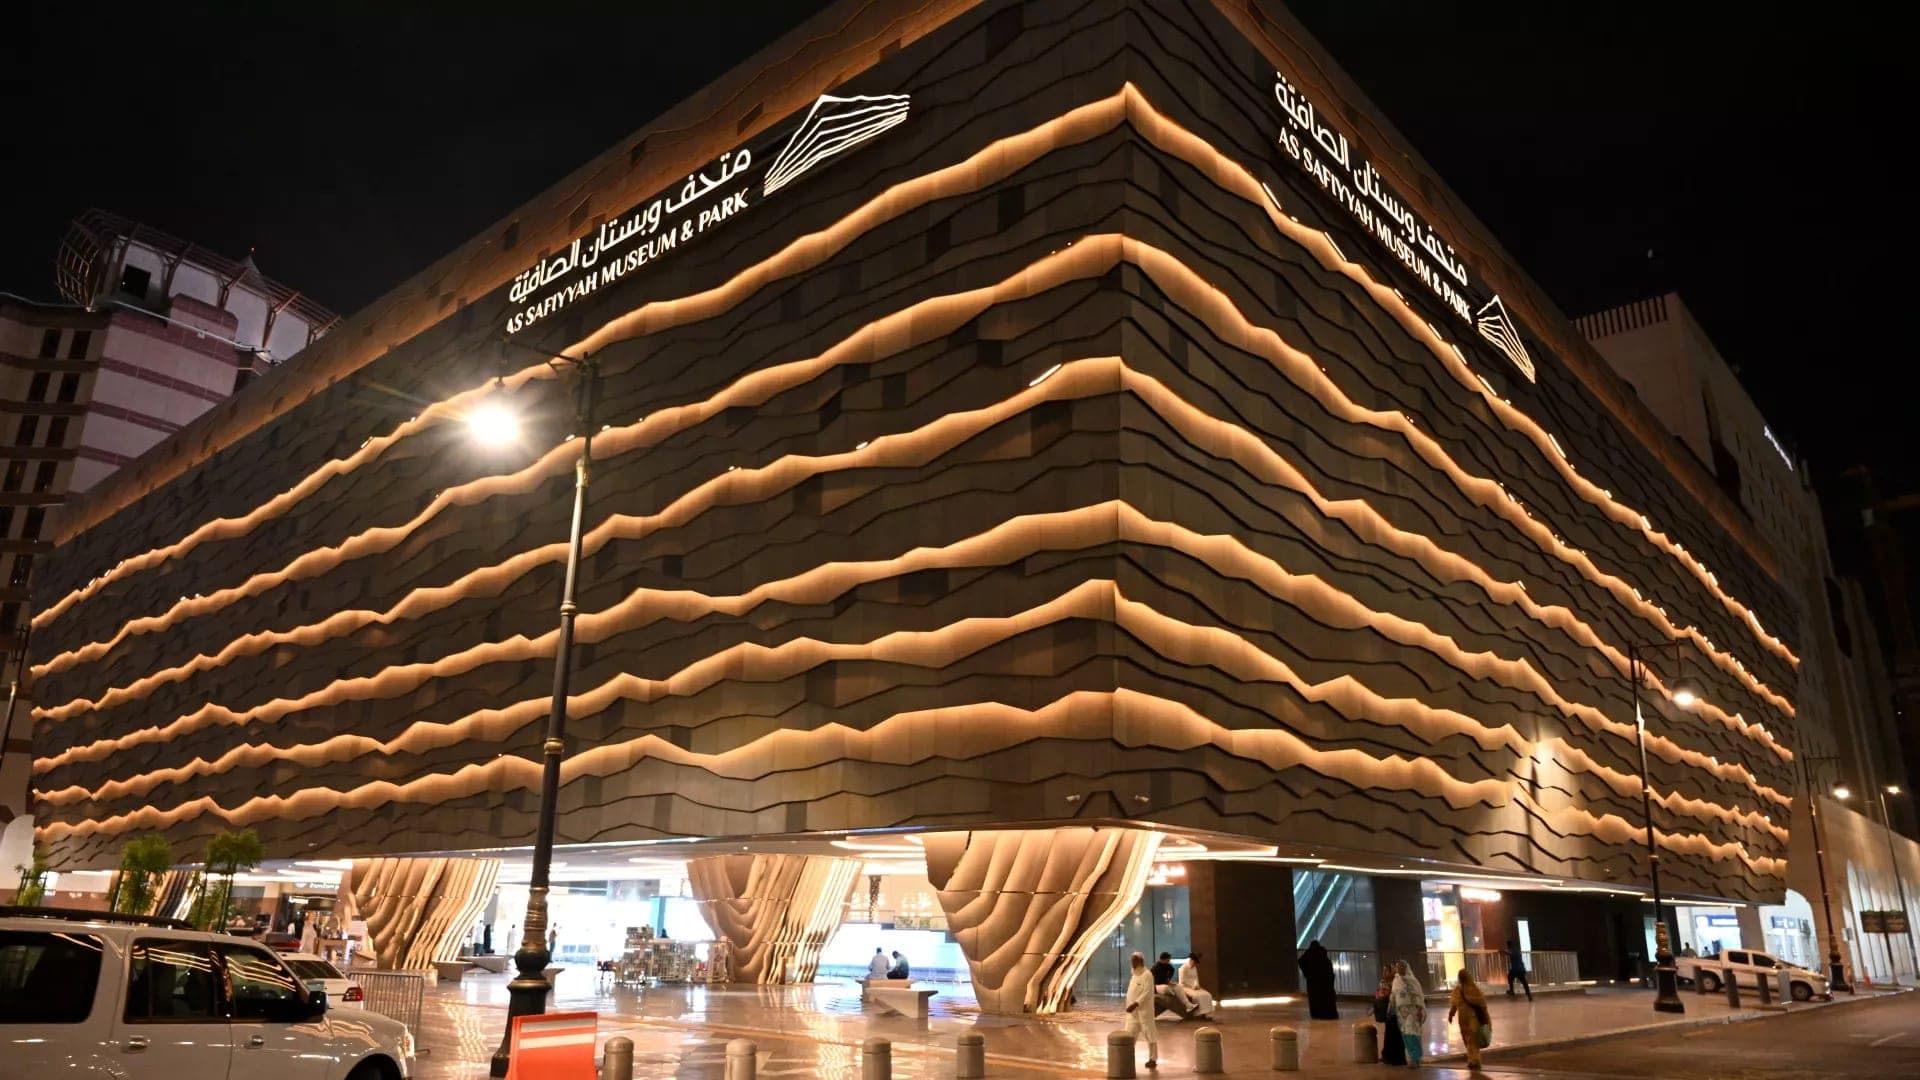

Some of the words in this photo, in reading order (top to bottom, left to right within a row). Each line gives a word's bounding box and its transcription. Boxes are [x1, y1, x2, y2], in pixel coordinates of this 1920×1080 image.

[665, 149, 752, 214] متحف
[1353, 160, 1416, 244] وبستان
[506, 312, 524, 334] AS
[525, 271, 598, 326] SAFIYYAH
[601, 227, 677, 285] MUSEUM
[680, 219, 694, 242] &
[698, 187, 749, 233] PARK
[581, 200, 663, 268] وبستان
[1278, 126, 1301, 160] AS
[1302, 146, 1374, 232] SAFIYYAH
[1375, 216, 1432, 287] MUSEUM
[1432, 272, 1442, 296] &
[1442, 280, 1473, 325] PARK
[1416, 224, 1468, 287] متحف
